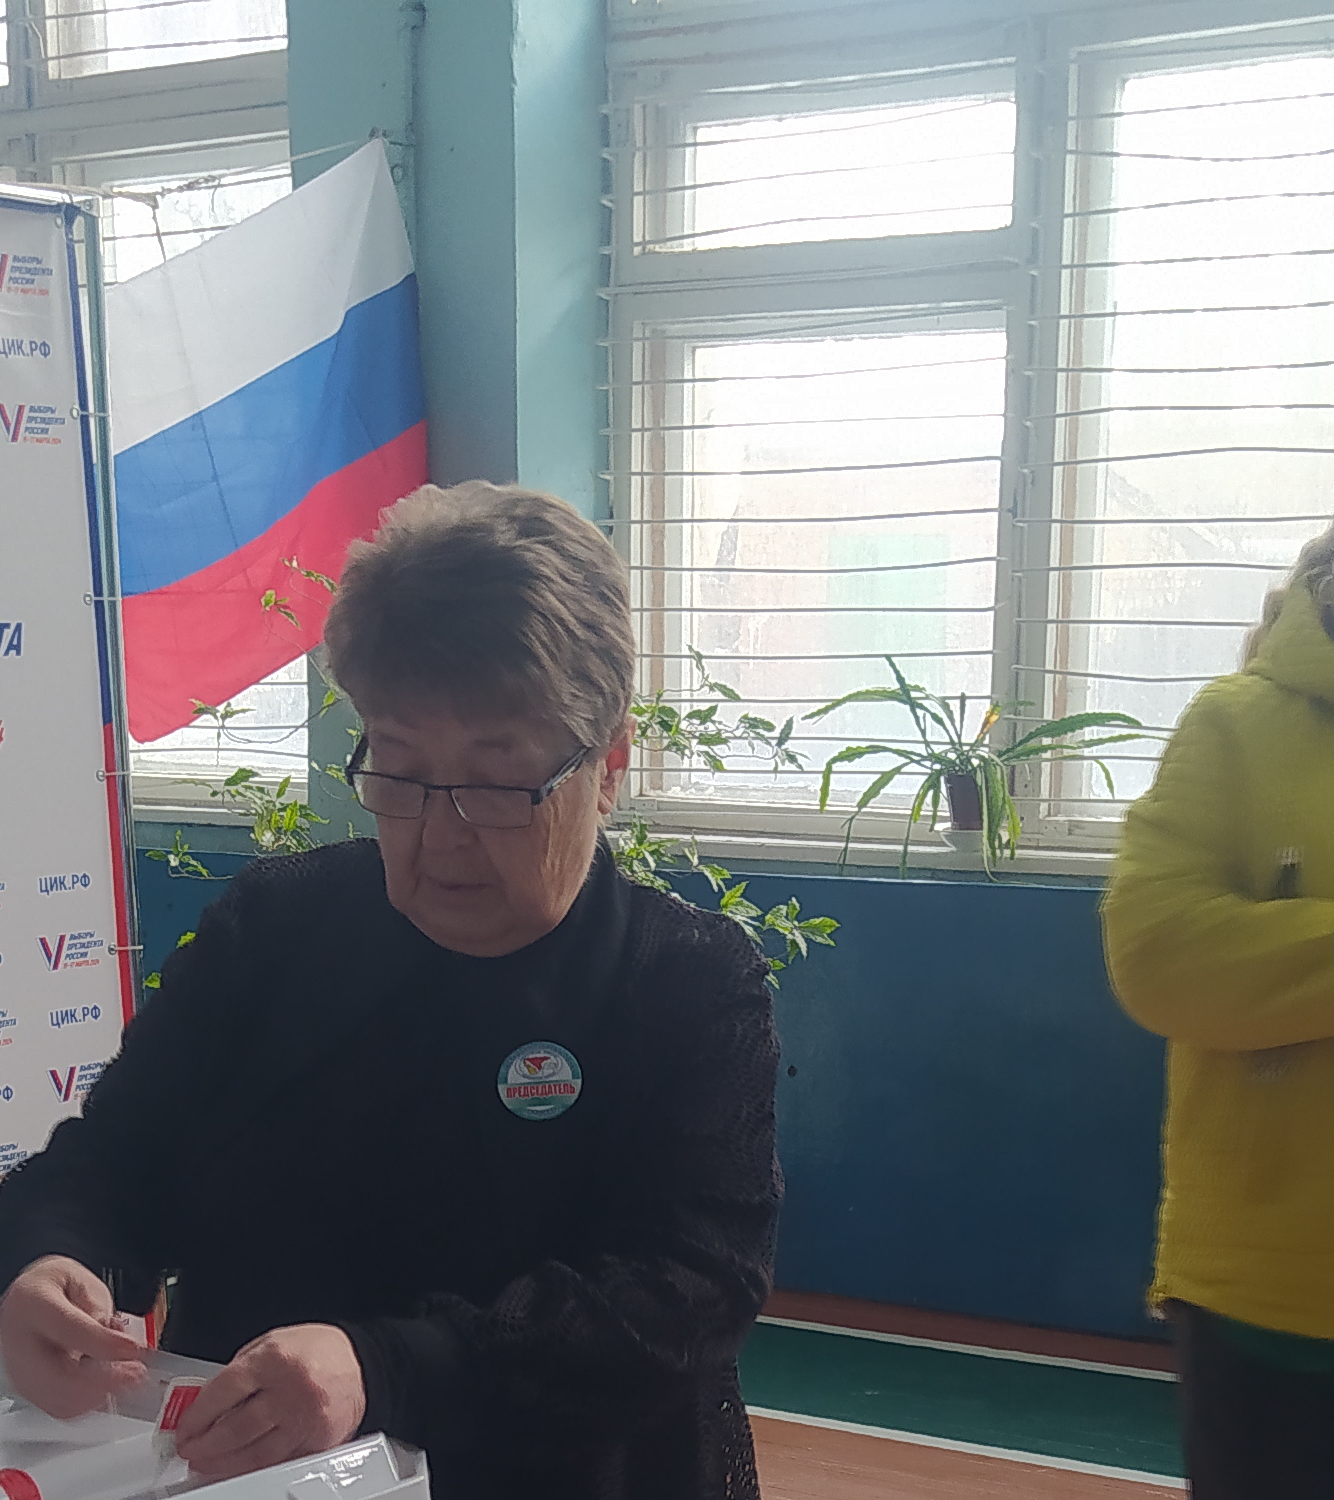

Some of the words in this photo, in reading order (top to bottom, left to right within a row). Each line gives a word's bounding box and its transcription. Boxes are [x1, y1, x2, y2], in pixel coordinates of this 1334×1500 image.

[38, 873, 91, 895] ЦИК.РФ
[68, 931, 97, 940] ВЫБОРЫ
[66, 940, 104, 950] ПРЕЗИДЕНТА
[64, 952, 89, 960] РОССИИ
[50, 1005, 101, 1028] ЦИК.РФ
[506, 1083, 575, 1098] ПРЕДСЕДАТЕЛЬ
